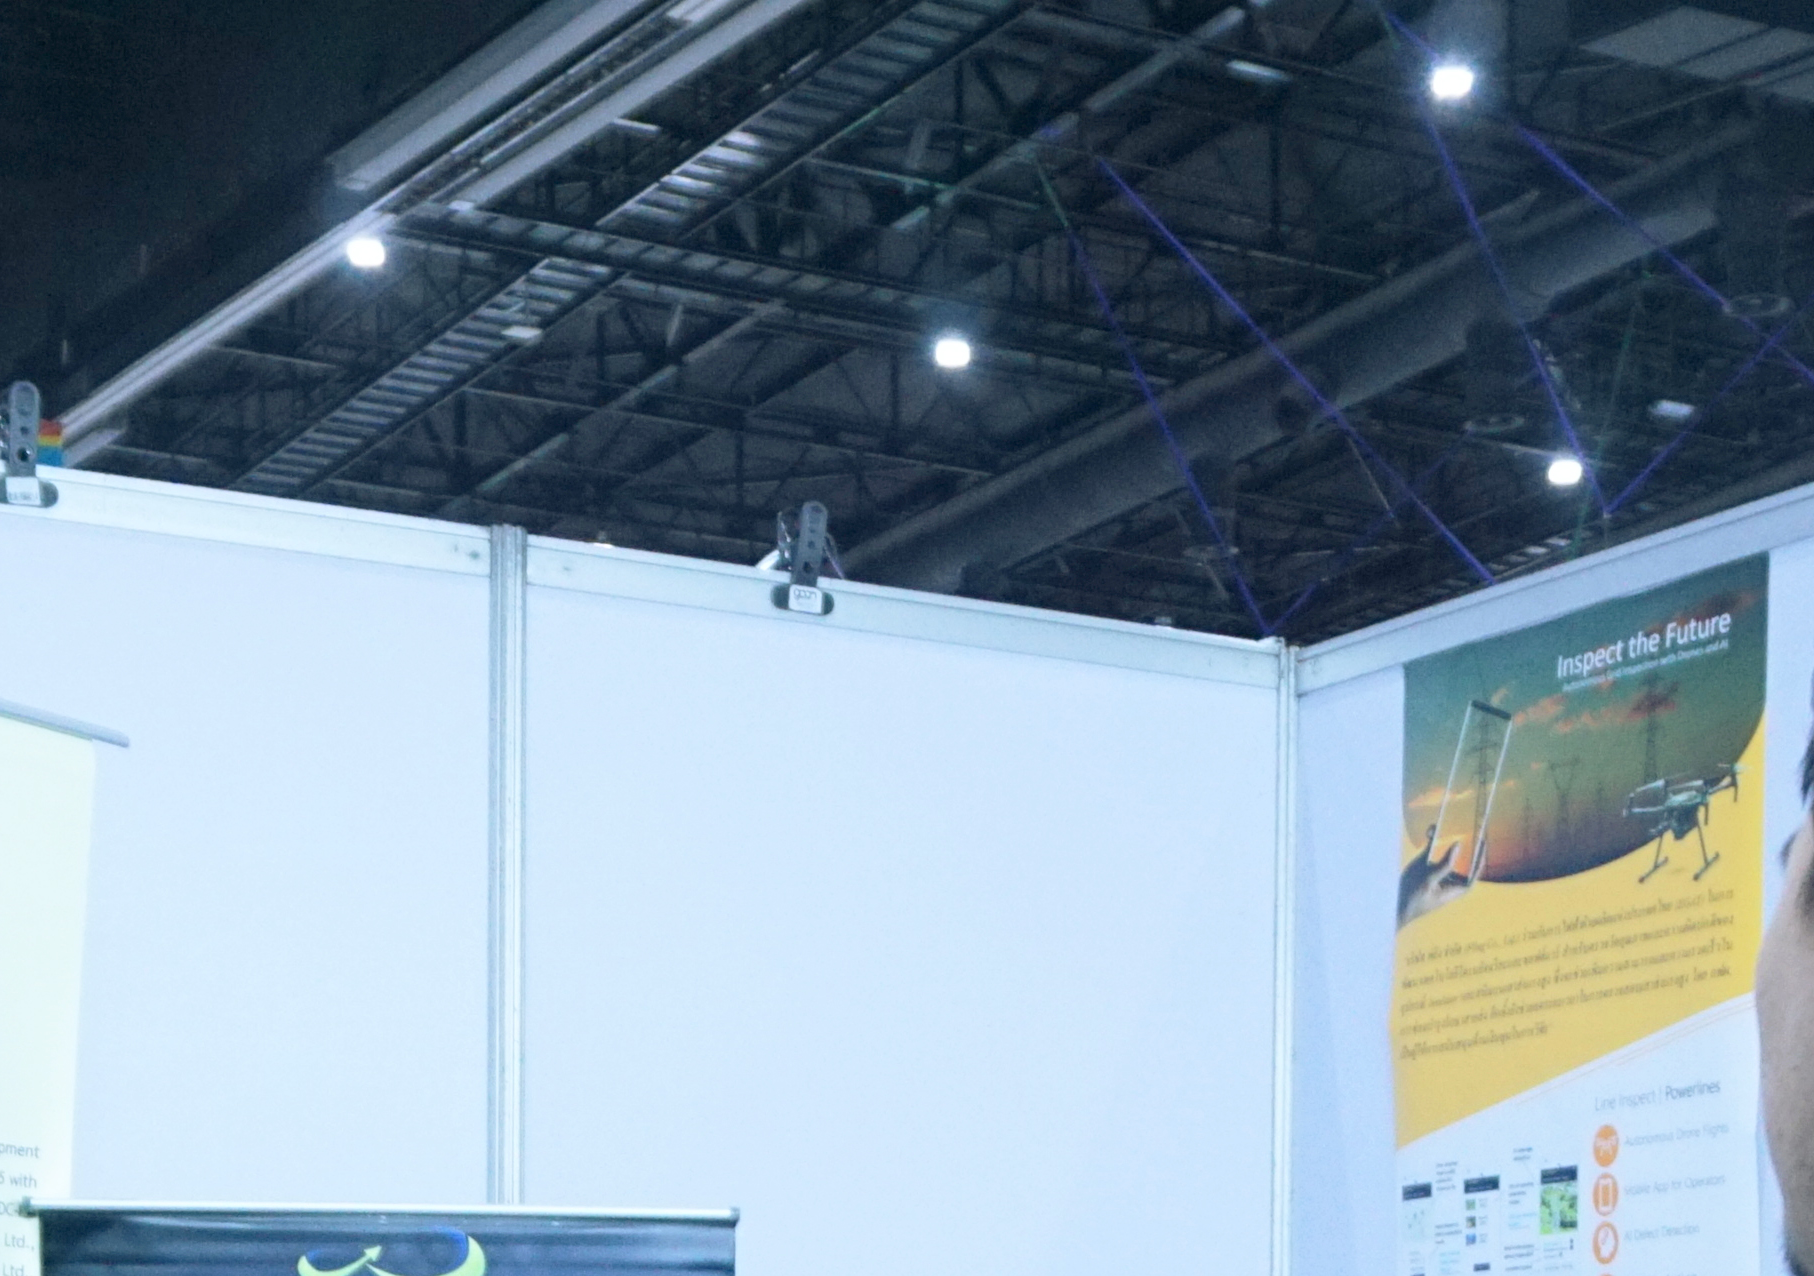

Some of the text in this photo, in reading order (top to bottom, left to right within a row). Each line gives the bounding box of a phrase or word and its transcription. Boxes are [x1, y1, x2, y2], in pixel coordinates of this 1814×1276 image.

[1557, 639, 1624, 679] Inspect
[1628, 631, 1660, 659] the
[1665, 612, 1731, 648] Future
[1619, 1089, 1656, 1108] Inspect
[1665, 1080, 1721, 1101] Powerlines
[9, 1172, 37, 1189] with
[4, 1232, 35, 1252] Ltd.,
